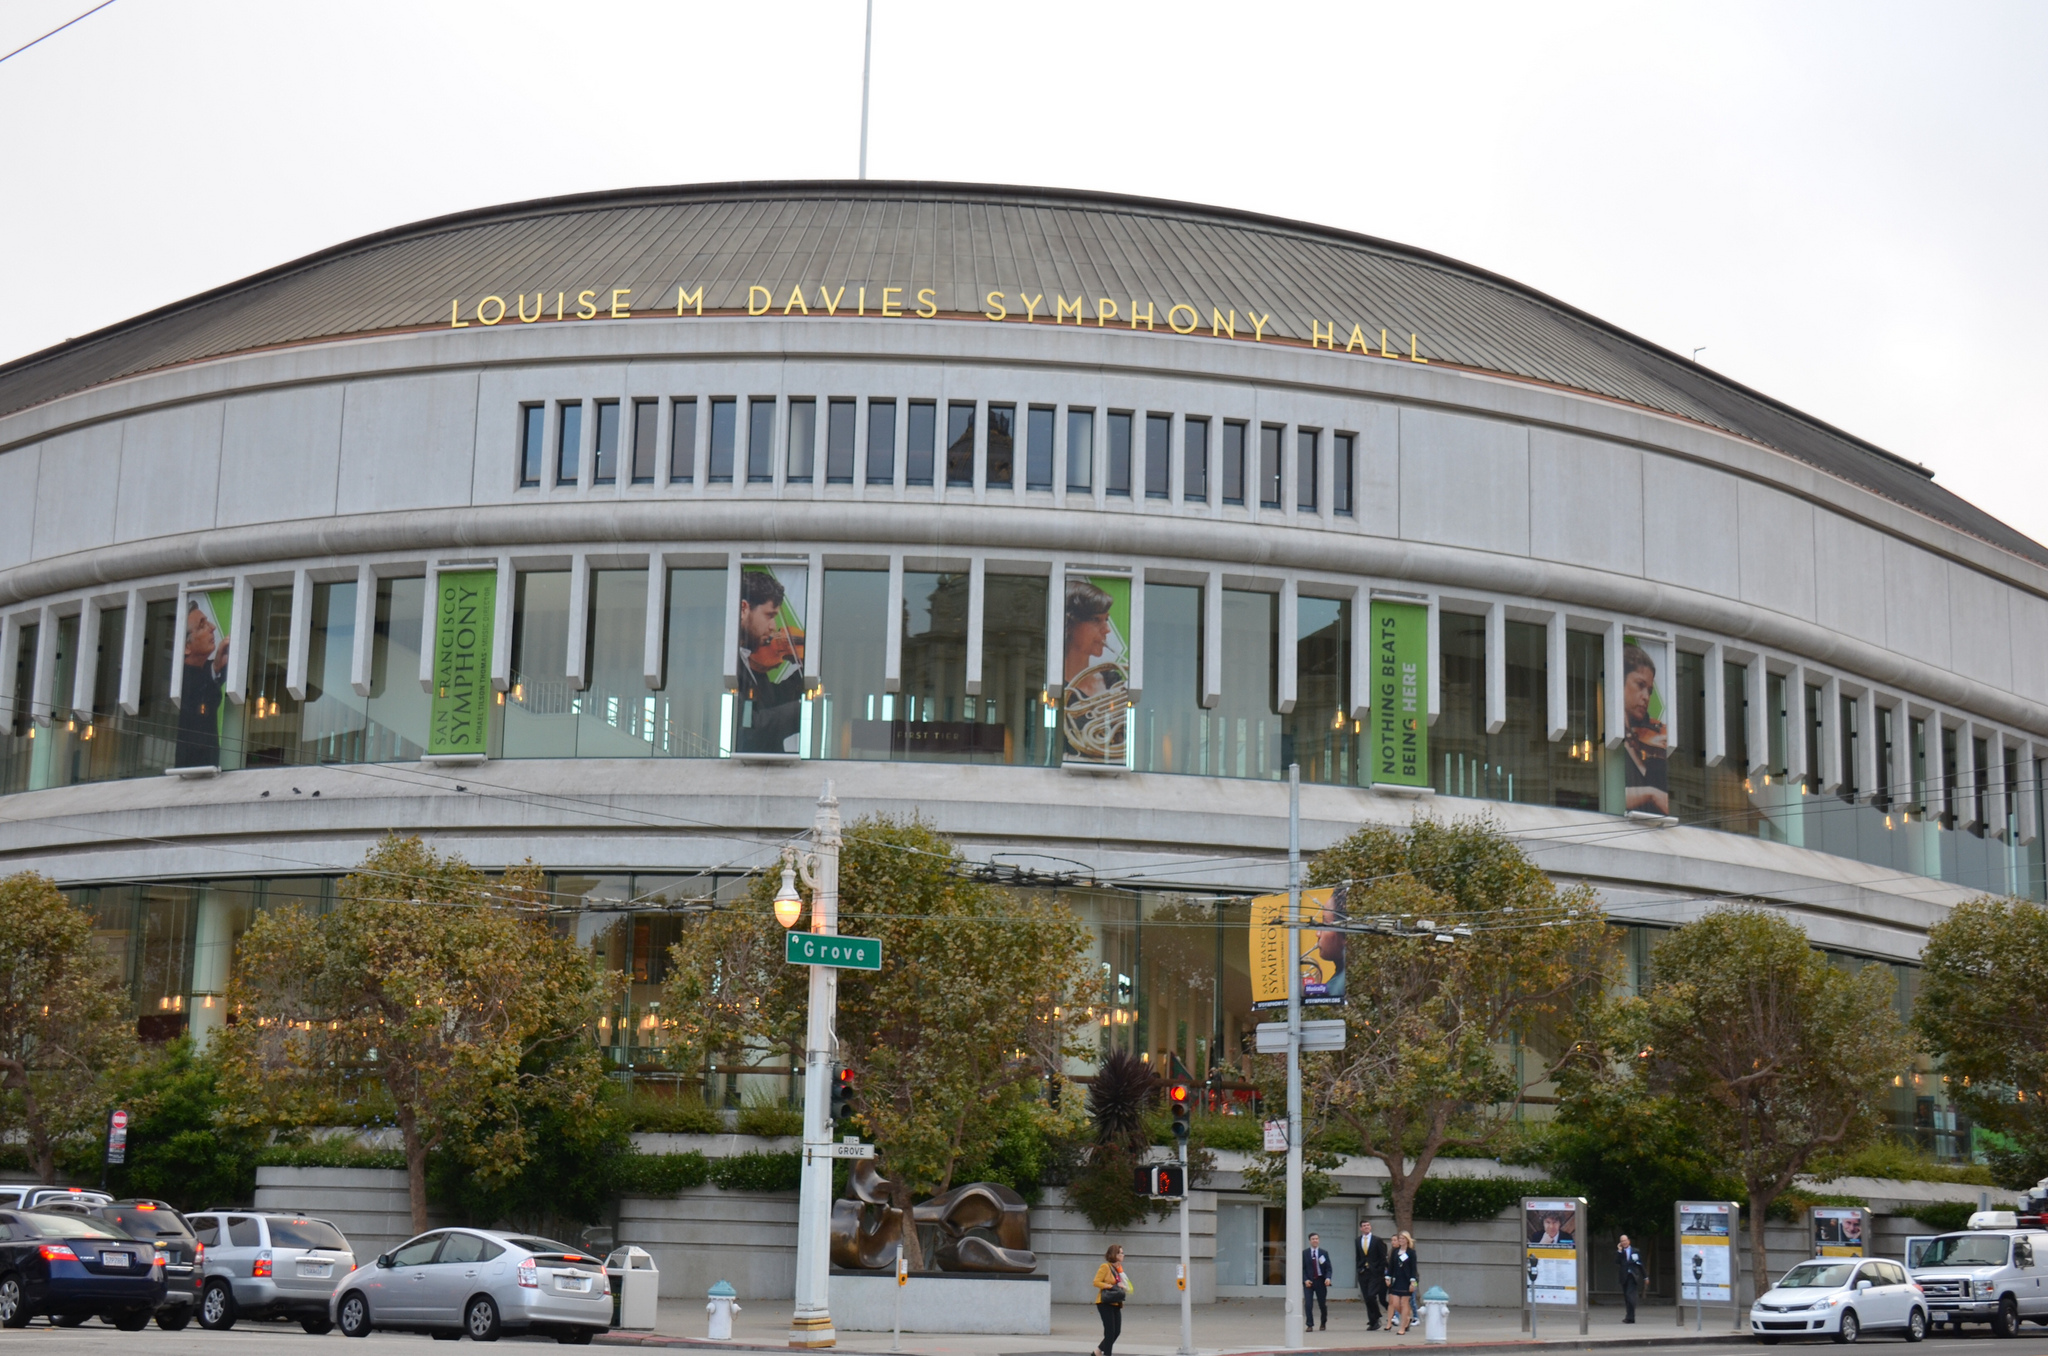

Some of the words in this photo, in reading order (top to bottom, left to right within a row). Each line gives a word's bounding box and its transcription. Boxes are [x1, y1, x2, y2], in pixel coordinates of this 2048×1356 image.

[451, 289, 632, 328] LOUISE
[676, 286, 704, 317] M
[748, 285, 938, 318] DAVIES
[985, 291, 1270, 342] SYMPHONY
[1312, 319, 1429, 364] HALL
[483, 586, 491, 622] DIRECTOR
[439, 587, 456, 699] FRANCISCO
[1381, 617, 1396, 677] BEATS
[450, 585, 478, 745] SYMPHONY
[478, 686, 486, 710] TILSON
[1402, 662, 1417, 712] HERE
[435, 711, 448, 746] SAN
[475, 713, 483, 744] MICHAEL
[897, 731, 928, 740] FIRST
[934, 731, 959, 740] TIER
[1381, 683, 1396, 775] NOTHING
[1403, 718, 1417, 776] BEING
[803, 940, 865, 961] Grove
[1261, 974, 1269, 995] SAN
[838, 1146, 865, 1156] GROVE
